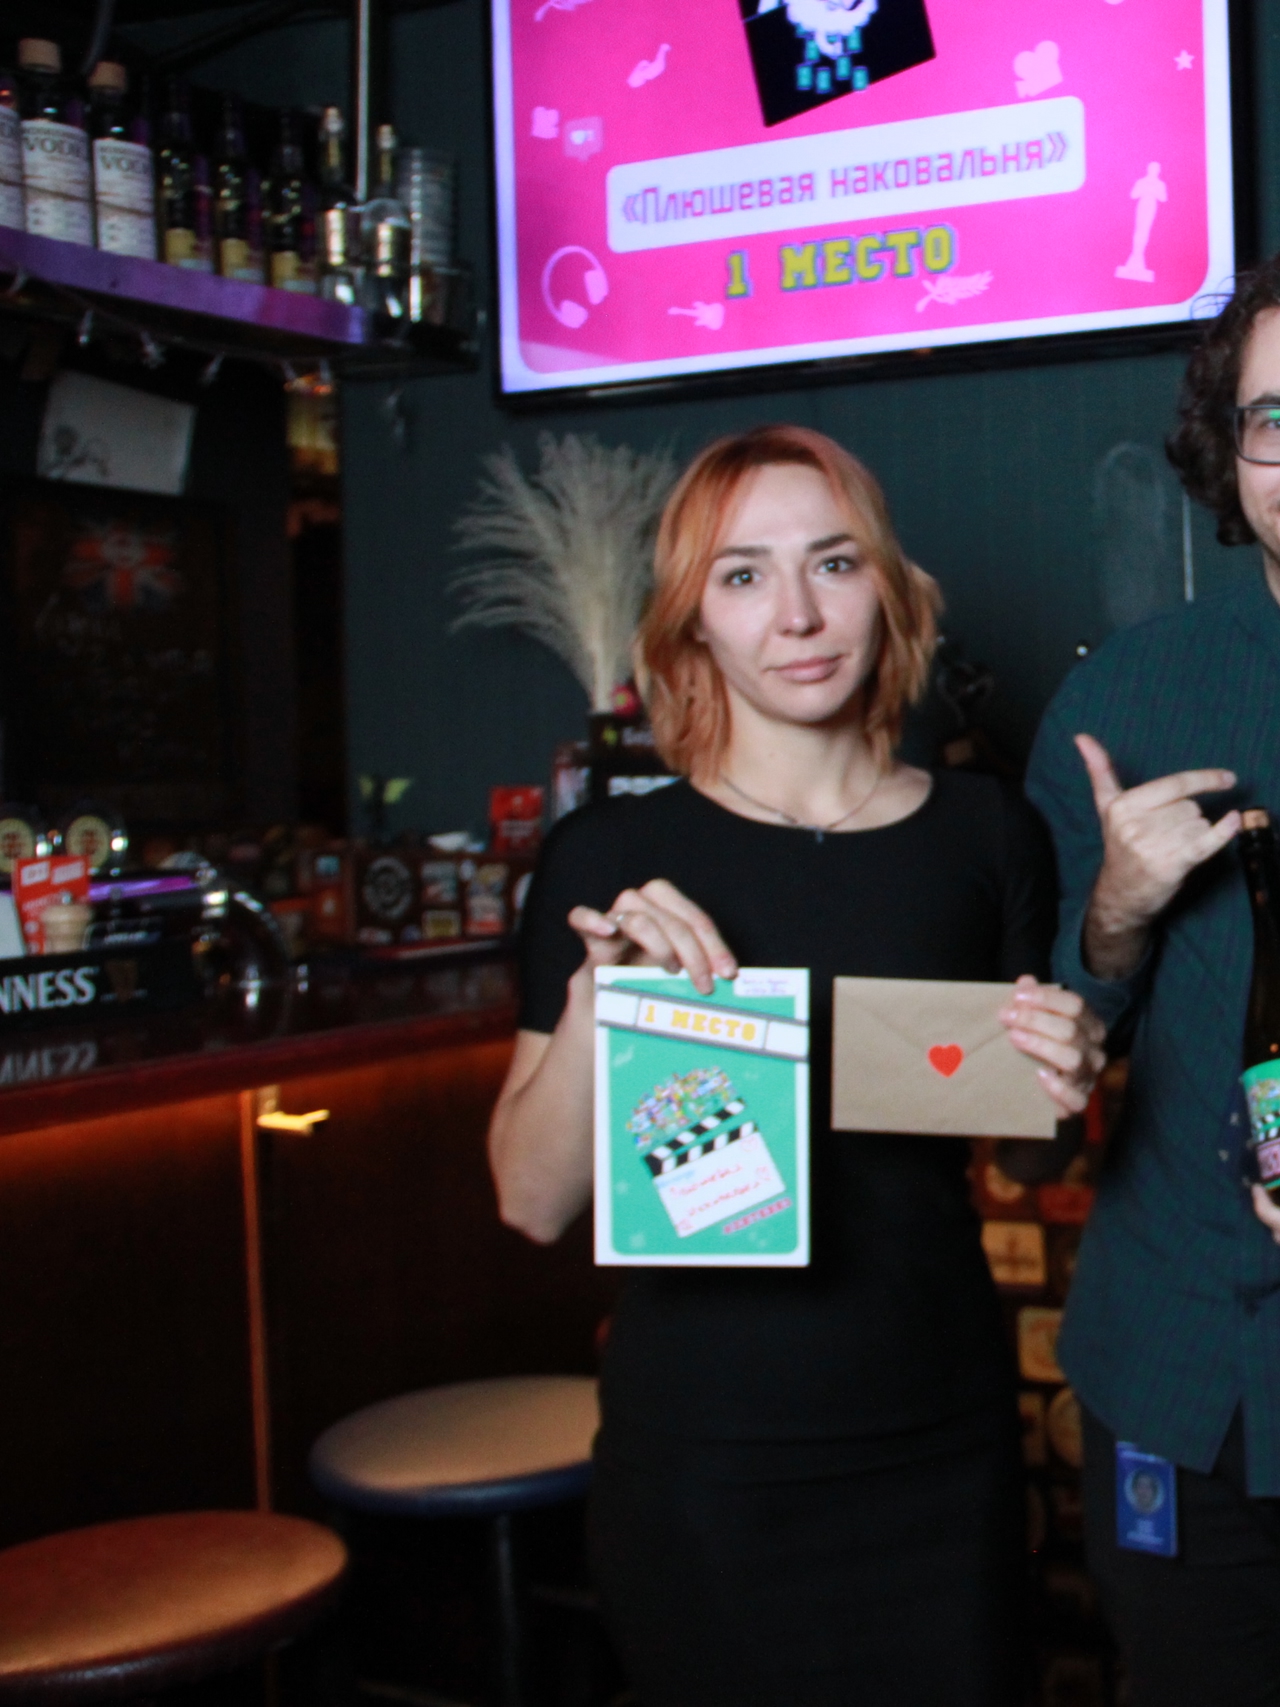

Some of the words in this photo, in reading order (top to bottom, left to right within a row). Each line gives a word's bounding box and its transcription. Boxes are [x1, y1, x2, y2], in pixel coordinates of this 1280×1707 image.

[622, 171, 815, 226] «Плюшевая
[829, 131, 1069, 199] наковальня»
[727, 251, 751, 298] 1
[780, 224, 957, 291] МЕСТО
[644, 1004, 656, 1024] 1
[670, 1008, 757, 1042] МЕСТО
